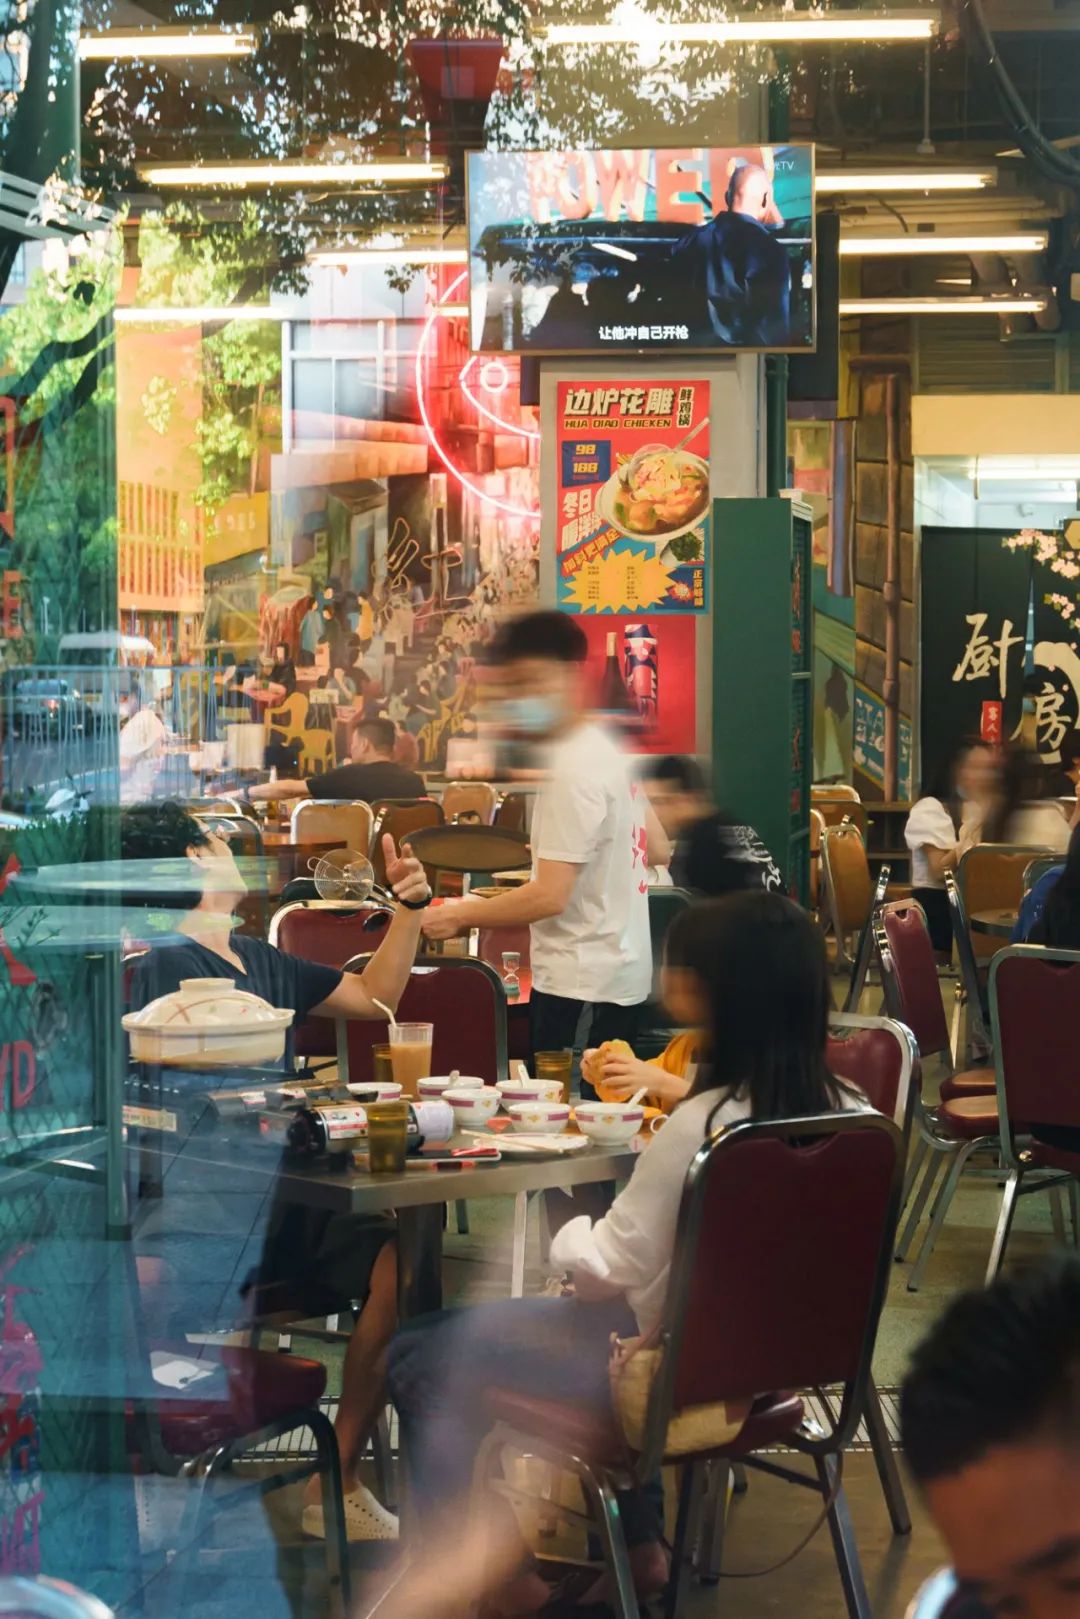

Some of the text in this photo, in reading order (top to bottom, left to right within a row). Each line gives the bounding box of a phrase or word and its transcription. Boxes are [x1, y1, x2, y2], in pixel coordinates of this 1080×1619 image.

[598, 325, 689, 340] 让他冲自己开枪
[564, 388, 675, 416] 边炉花雕
[565, 418, 588, 428] HUA
[624, 418, 671, 428] CHICKEN
